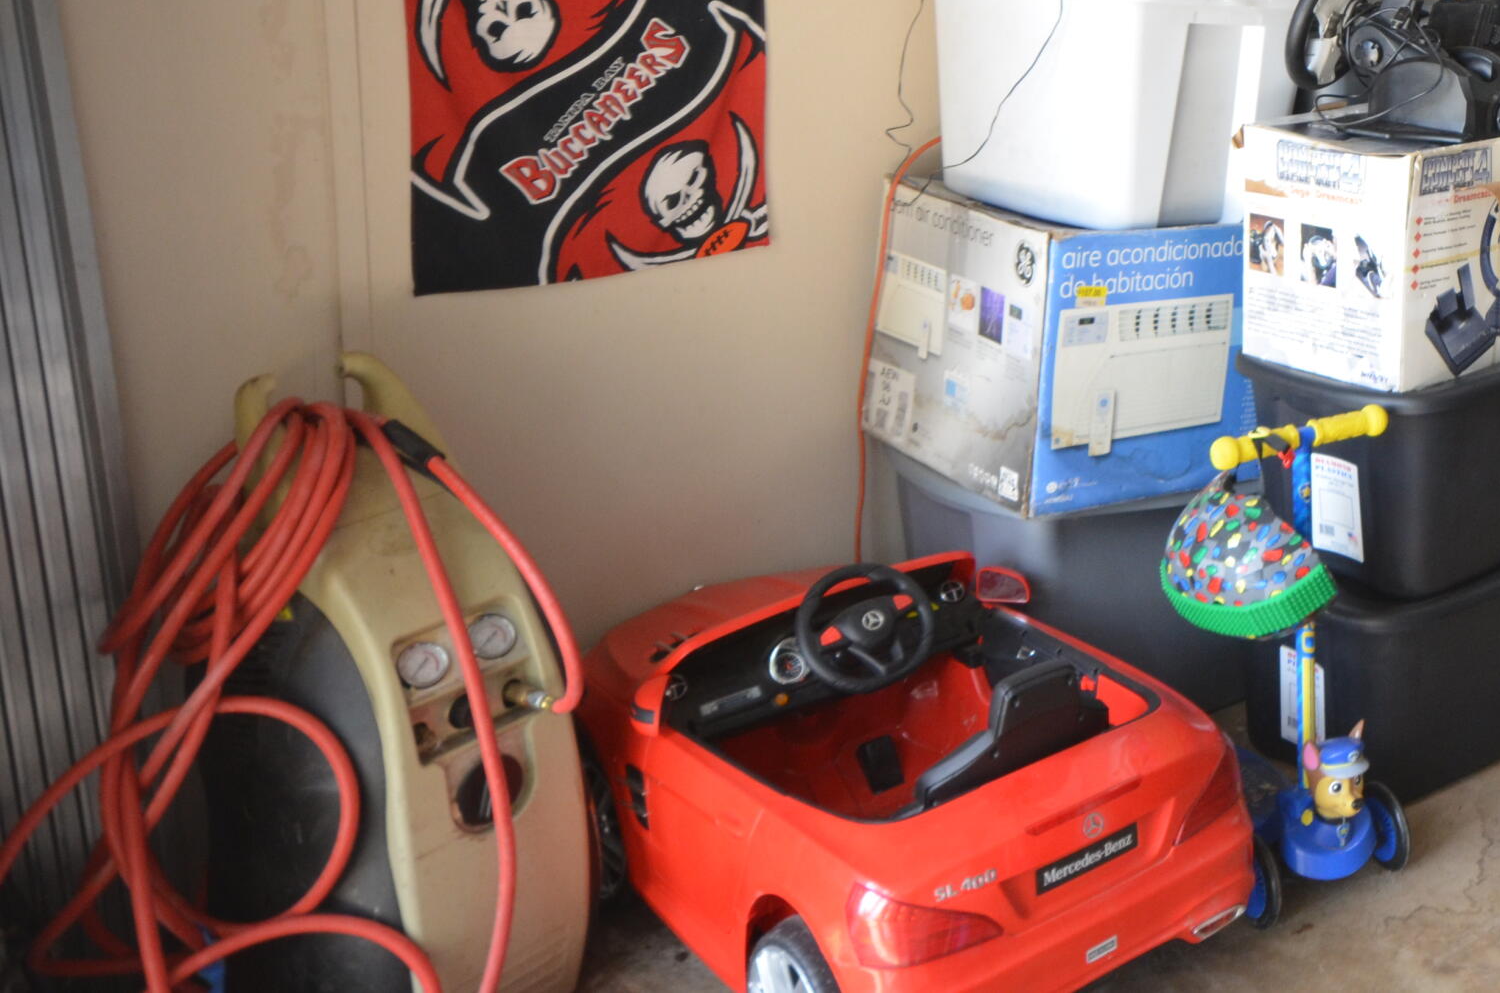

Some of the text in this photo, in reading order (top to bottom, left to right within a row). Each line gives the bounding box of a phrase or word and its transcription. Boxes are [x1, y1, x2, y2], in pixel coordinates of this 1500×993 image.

[498, 16, 692, 205] BUCCANEERS
[1062, 246, 1102, 270] aire
[1043, 832, 1133, 887] Mercedes-Benz
[934, 867, 998, 903] SL 400
